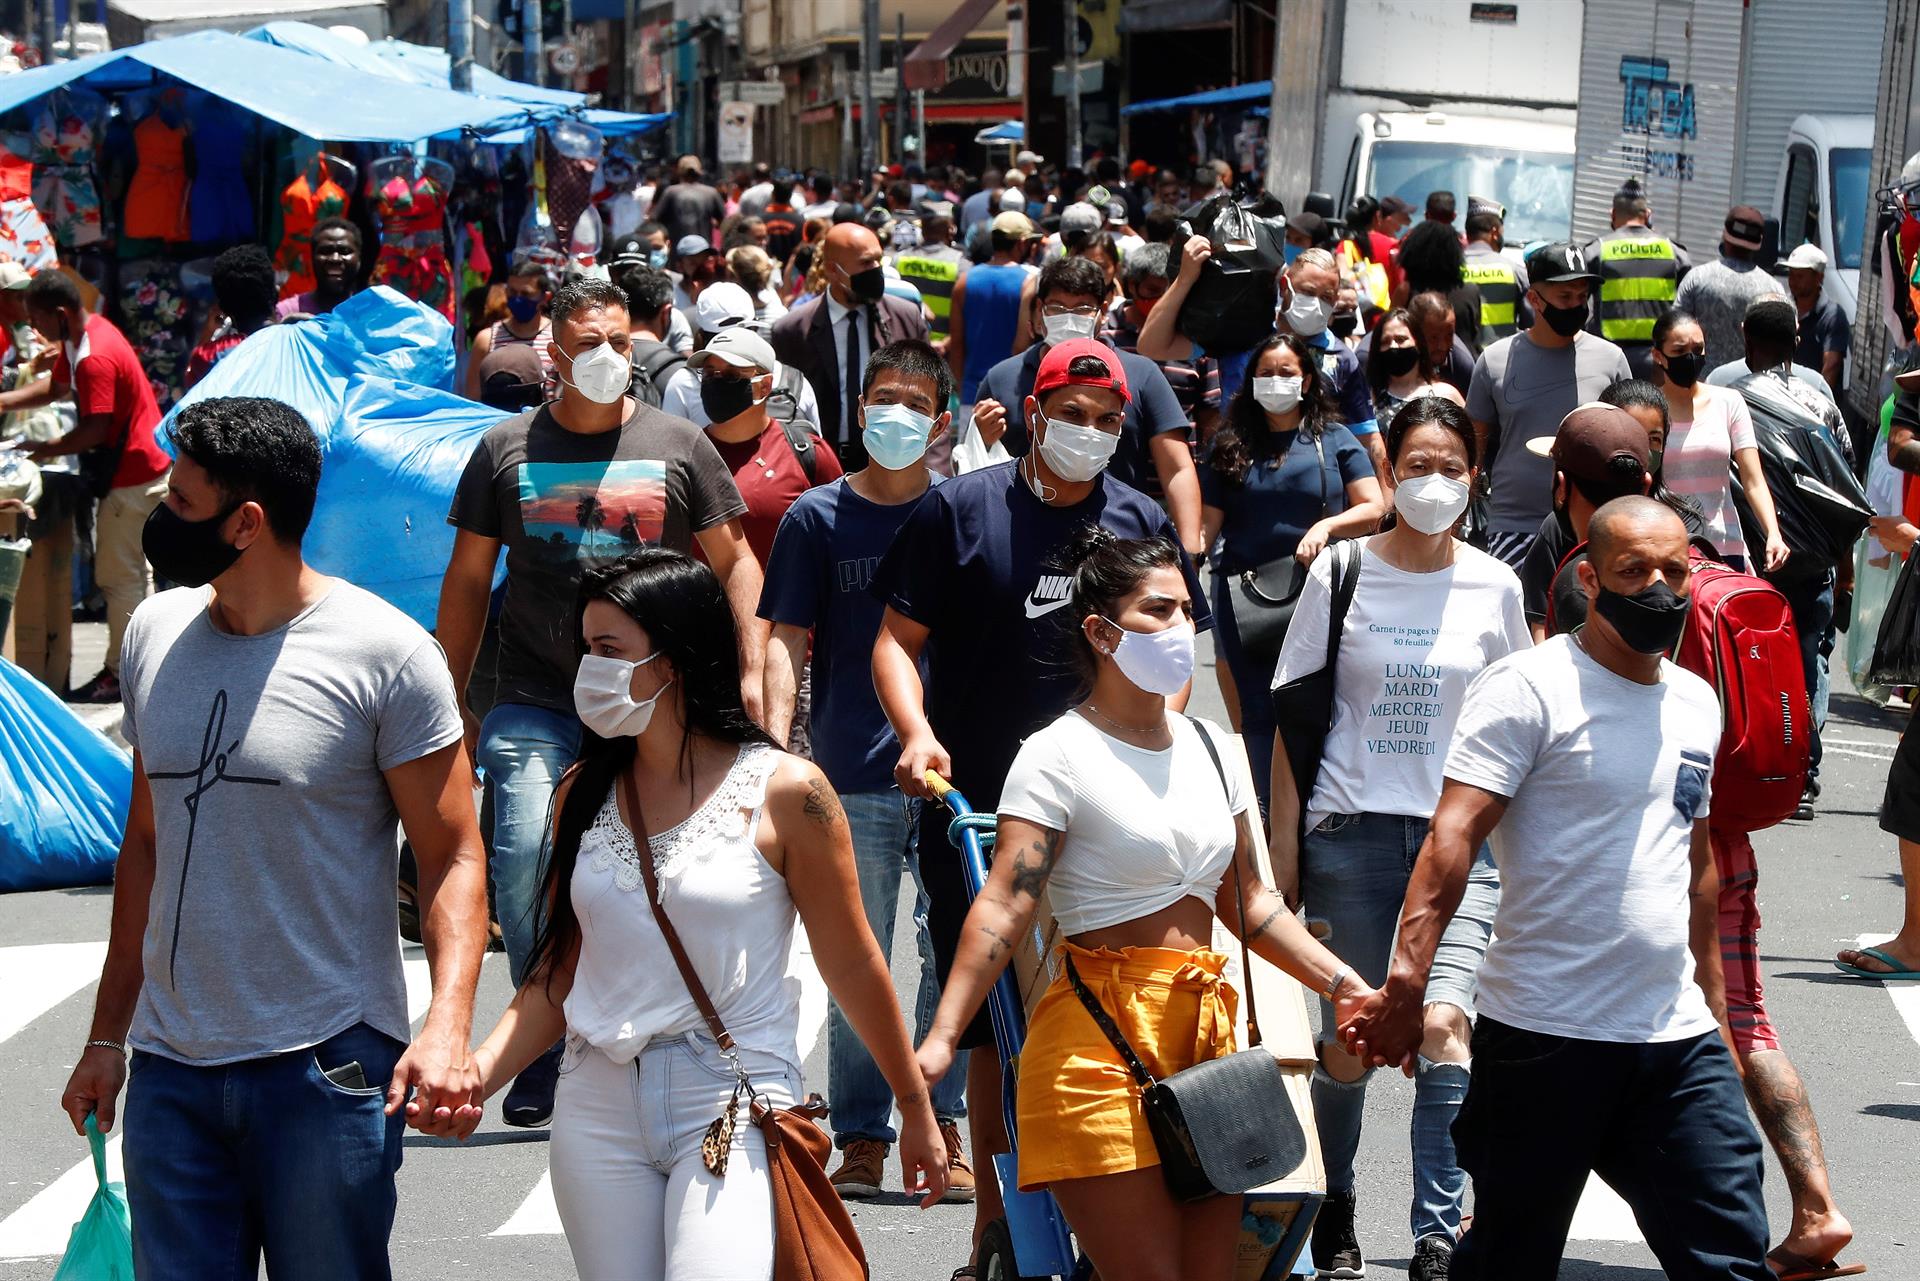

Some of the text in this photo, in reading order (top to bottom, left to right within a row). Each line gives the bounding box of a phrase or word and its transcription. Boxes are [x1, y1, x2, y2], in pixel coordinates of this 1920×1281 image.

[944, 54, 1007, 93] EIXOTO
[1461, 269, 1504, 278] OLICIA
[1369, 624, 1396, 634] Carnet
[1407, 628, 1430, 636] pages
[1405, 639, 1434, 647] feuilles
[1385, 663, 1442, 679] LUNDI
[1384, 682, 1440, 698] MARDI
[1368, 701, 1444, 718] MERCREDI
[1386, 720, 1429, 736] JEUDI
[1367, 739, 1436, 756] VENDREDI
